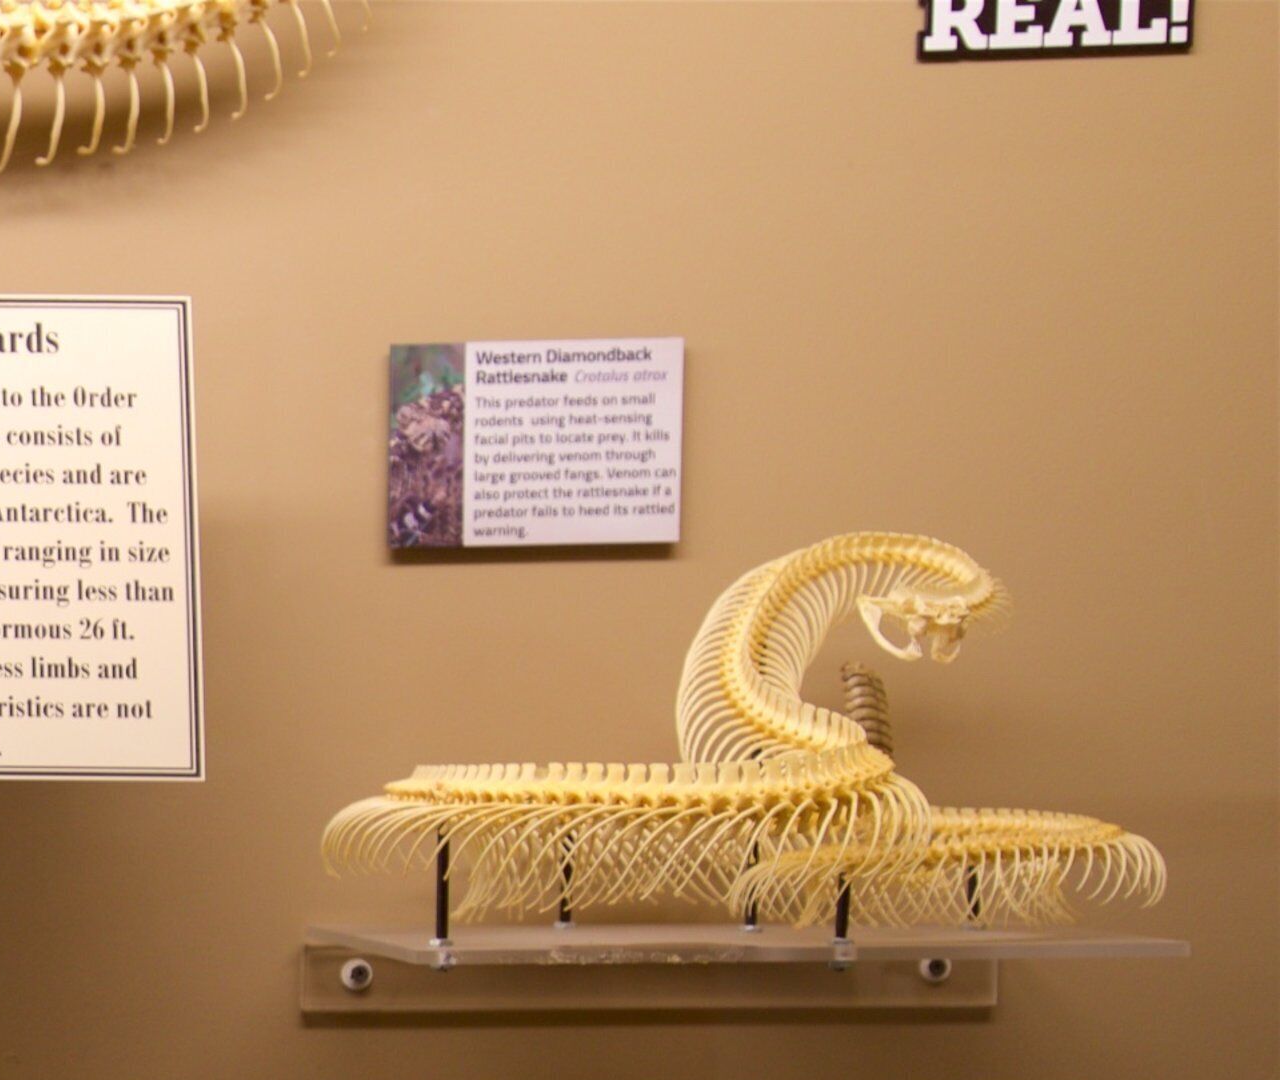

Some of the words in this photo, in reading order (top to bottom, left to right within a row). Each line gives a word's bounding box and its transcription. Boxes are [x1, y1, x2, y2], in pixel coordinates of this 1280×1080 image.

[923, 0, 1189, 51] REAL!
[476, 351, 542, 365] Western
[546, 348, 651, 364] Diamondback
[475, 368, 569, 385] Rattlesnake
[574, 370, 629, 383] Crotalus
[1, 387, 23, 408] to
[30, 385, 66, 408] the
[72, 386, 138, 409] Order
[475, 396, 502, 409] This
[504, 396, 559, 411] predator
[562, 394, 599, 407] feeds
[601, 396, 618, 406] on
[620, 392, 656, 406] small
[474, 415, 524, 428] rodents
[530, 415, 566, 429] using
[568, 413, 653, 427] heat-sensing
[6, 424, 93, 447] consists
[100, 424, 122, 447] of
[474, 433, 509, 446] facial
[511, 433, 536, 448] pits
[538, 433, 553, 444] to
[555, 432, 595, 444] locate
[632, 430, 641, 442] It
[644, 429, 671, 442] kills
[474, 452, 490, 467] by
[492, 451, 556, 466] delivering
[558, 451, 602, 462] venom
[604, 448, 656, 464] through
[62, 462, 102, 485] and
[109, 469, 147, 486] are
[473, 470, 506, 486] large
[509, 469, 561, 485] grooved
[606, 467, 652, 480] Venom
[654, 468, 677, 479] can
[473, 489, 501, 501] also
[502, 488, 549, 503] protect
[552, 487, 574, 499] the
[576, 485, 649, 499] rattlesnake
[652, 484, 662, 496] if
[664, 487, 672, 497] a
[126, 501, 168, 524] The
[473, 506, 528, 522] predator
[531, 505, 559, 518] fails
[561, 505, 576, 517] to
[578, 504, 610, 517] heed
[613, 504, 629, 516] its
[632, 503, 675, 516] rattled
[3, 539, 93, 568] ranging
[99, 540, 121, 563] in
[127, 540, 171, 563] size
[77, 578, 118, 601] less
[125, 579, 175, 603] than
[79, 617, 105, 640] 26
[112, 618, 135, 641] ft.
[30, 655, 91, 679] limbs
[97, 656, 138, 680] and
[71, 702, 109, 719] are
[116, 699, 152, 720] not
